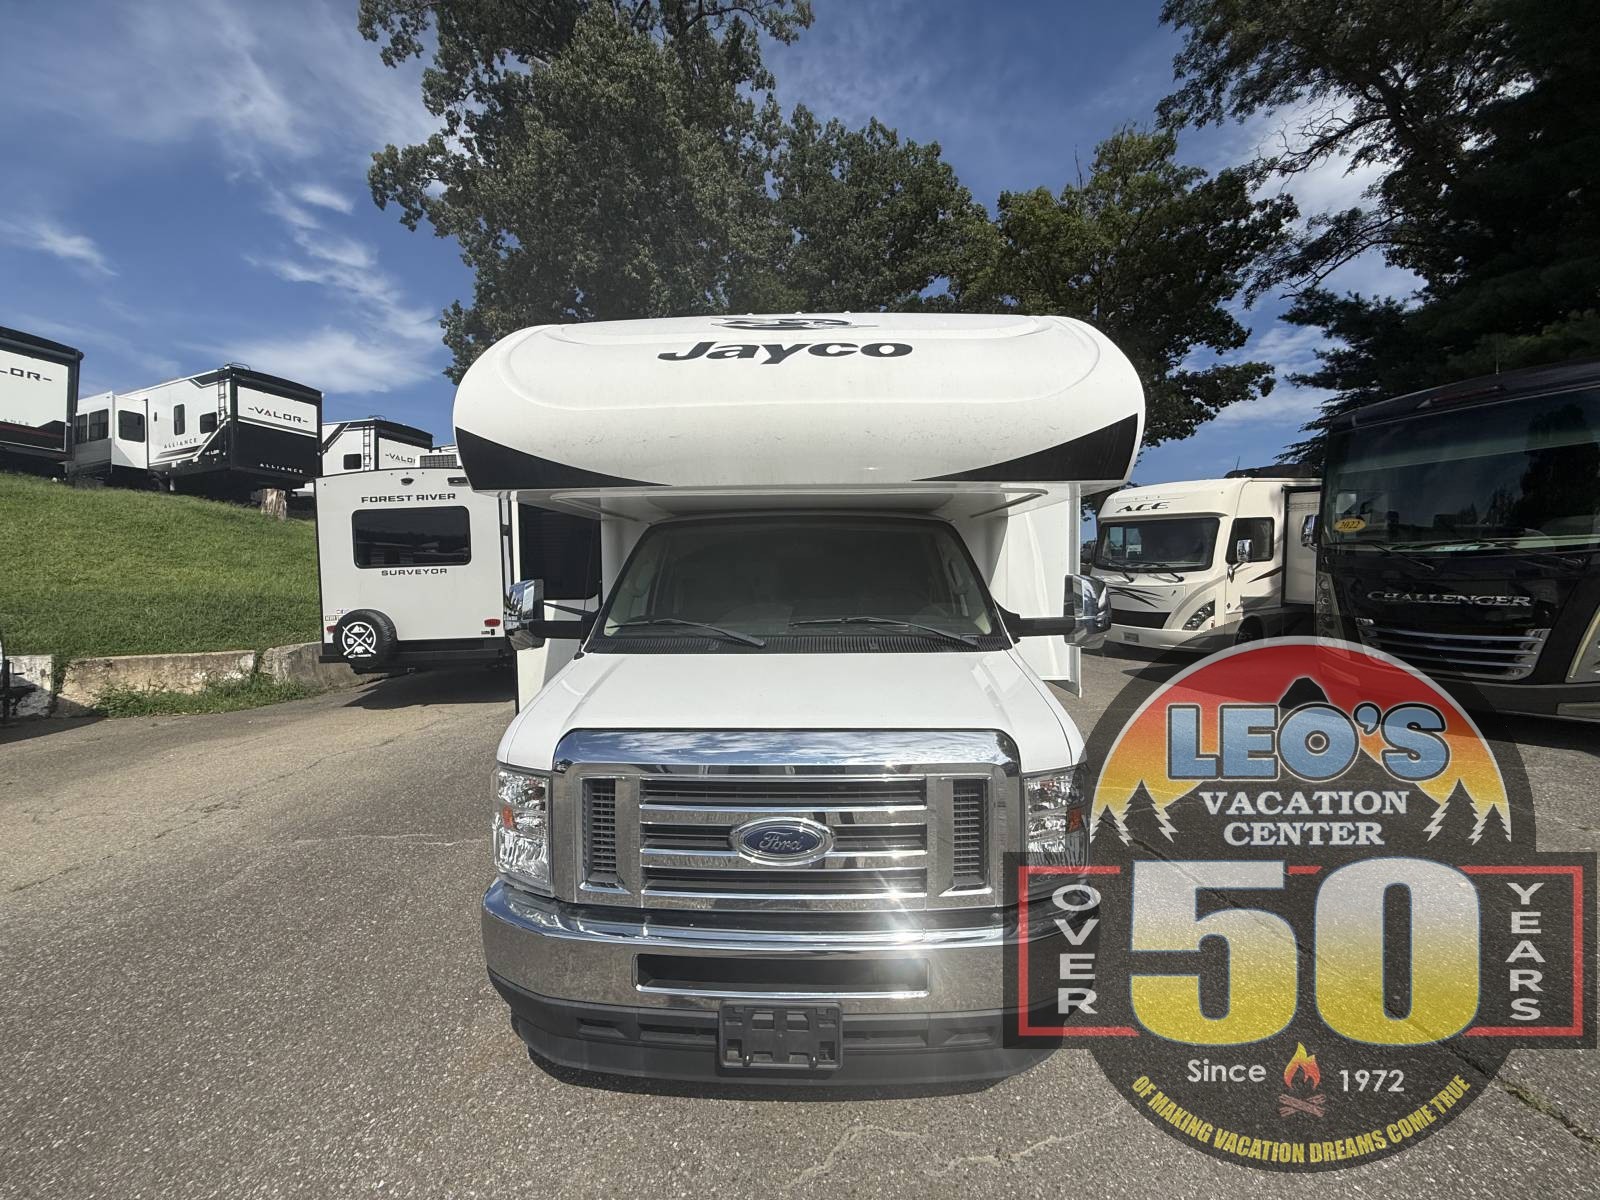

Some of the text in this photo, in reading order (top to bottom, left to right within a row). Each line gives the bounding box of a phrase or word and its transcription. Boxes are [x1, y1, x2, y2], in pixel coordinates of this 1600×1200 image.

[657, 341, 913, 365] Jayco
[260, 463, 303, 474] ALLIANCE
[361, 493, 456, 503] FOREST RIVER
[381, 568, 447, 576] SURVEYOR
[1367, 591, 1532, 607] CHALLENGER
[759, 832, 807, 850] Ford
